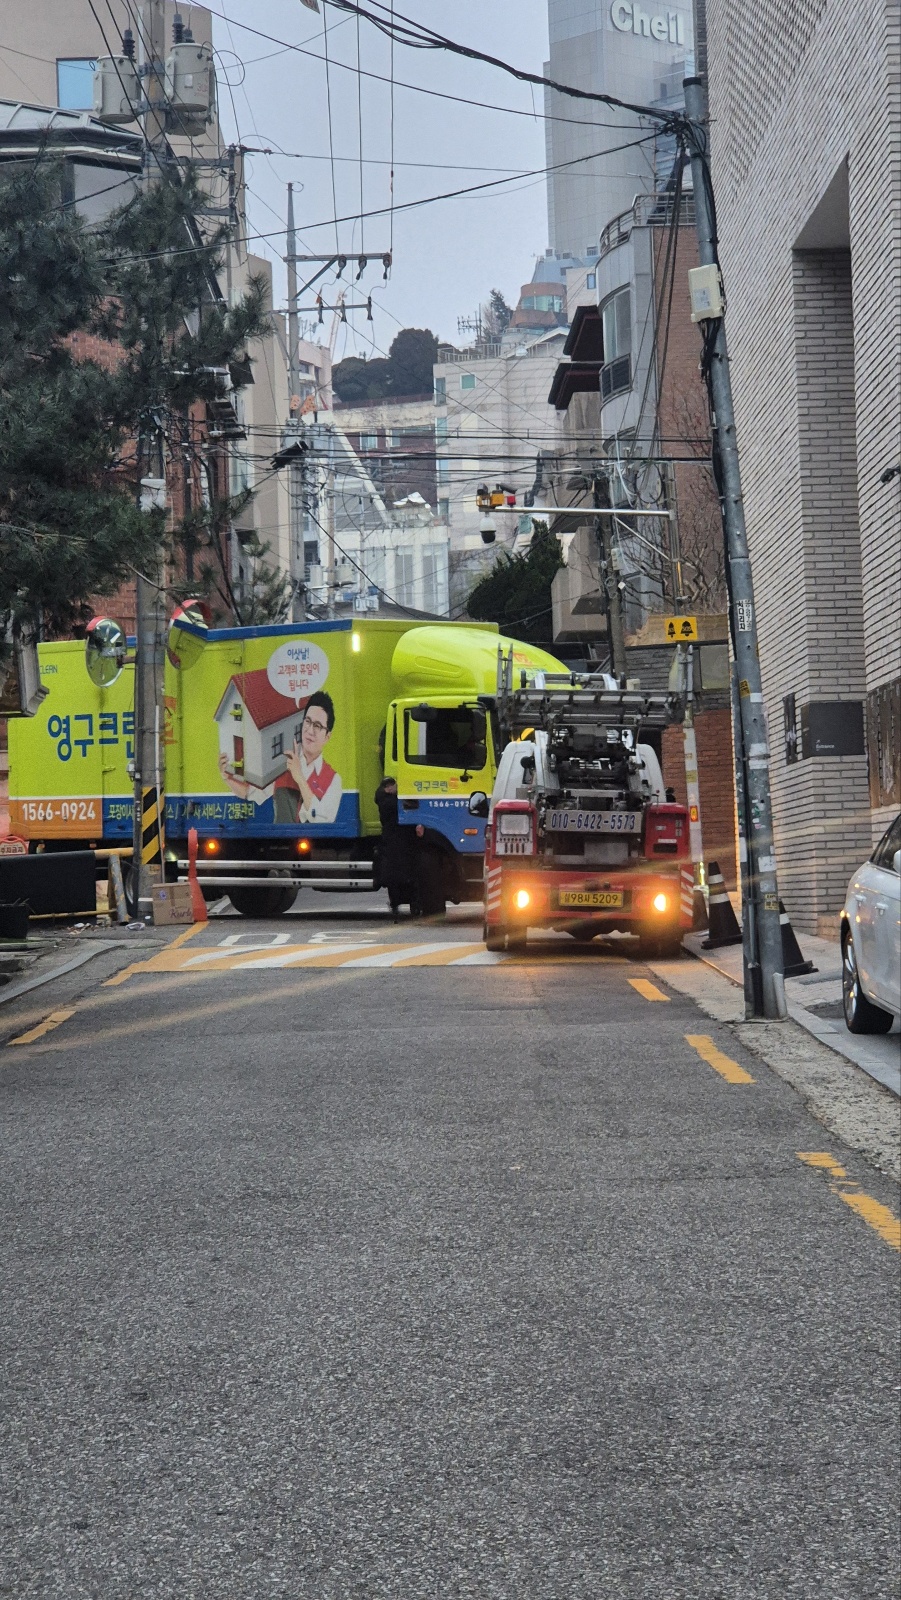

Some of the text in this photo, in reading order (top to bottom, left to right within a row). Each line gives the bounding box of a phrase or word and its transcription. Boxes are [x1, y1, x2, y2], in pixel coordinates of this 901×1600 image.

[611, 0, 684, 45] Cheil
[287, 647, 310, 660] 이삿날!
[278, 663, 320, 676] 고객의 휴일이
[288, 679, 309, 691] 됩니다
[413, 780, 449, 793] 영구크린
[428, 800, 470, 808] 1566-092
[22, 802, 96, 820] 1566-0924
[551, 813, 637, 831] 010-6422-5573
[592, 892, 619, 905] 5209
